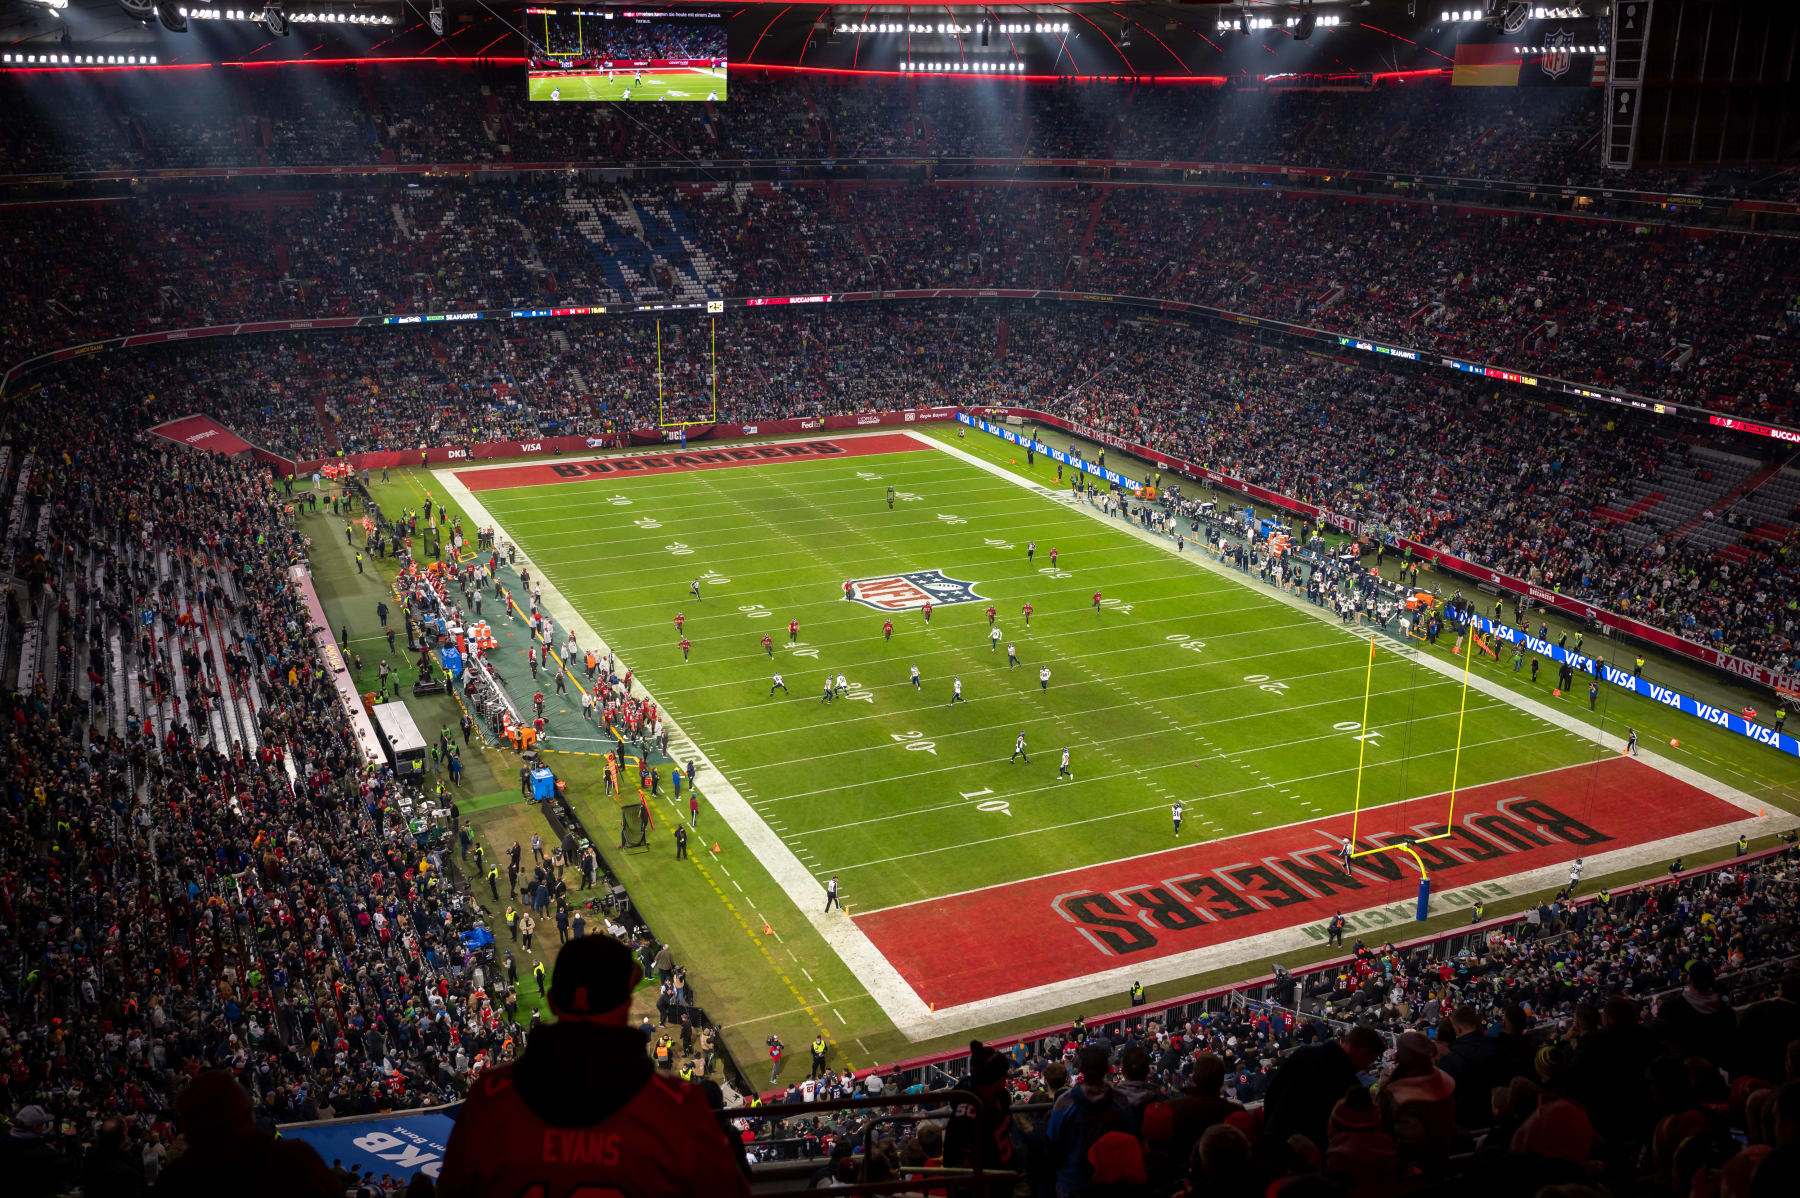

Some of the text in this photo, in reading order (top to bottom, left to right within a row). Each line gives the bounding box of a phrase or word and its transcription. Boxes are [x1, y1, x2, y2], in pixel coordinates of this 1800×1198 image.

[446, 312, 478, 321] SEAHAWKS
[1390, 349, 1416, 360] SEAHAWKS
[960, 412, 970, 424] VISA
[988, 424, 1000, 436] VISA
[1003, 430, 1015, 442] VISA
[1072, 422, 1127, 450] RAISE THE FLAGS
[520, 442, 542, 452] VISA
[1018, 436, 1031, 448] VISA
[1034, 442, 1048, 456] VISA
[551, 441, 846, 478] BUCCANEERS
[1052, 448, 1064, 462] VISA
[1068, 455, 1082, 469] VISA
[1086, 462, 1100, 476] VISA
[1104, 469, 1120, 484] VISA
[1124, 476, 1140, 491] VISA
[856, 578, 932, 608] NFL
[144, 610, 153, 624] 12
[738, 604, 773, 618] 50
[1166, 634, 1206, 649] 30
[1524, 634, 1552, 658] VISA
[1564, 649, 1592, 674] VISA
[1604, 665, 1636, 692] VISA
[1716, 652, 1800, 693] RAISE THE
[1243, 674, 1290, 692] 20
[1648, 683, 1681, 709] VISA
[1694, 700, 1729, 728] VISA
[1333, 721, 1384, 741] 10
[1743, 720, 1780, 748] VISA
[890, 731, 936, 751] 20
[960, 787, 1010, 812] 10
[1051, 797, 1616, 956] BUCCANEERS
[1301, 882, 1510, 940] END ACISM
[392, 1126, 428, 1144] Bank
[544, 1128, 626, 1168] EVANS
